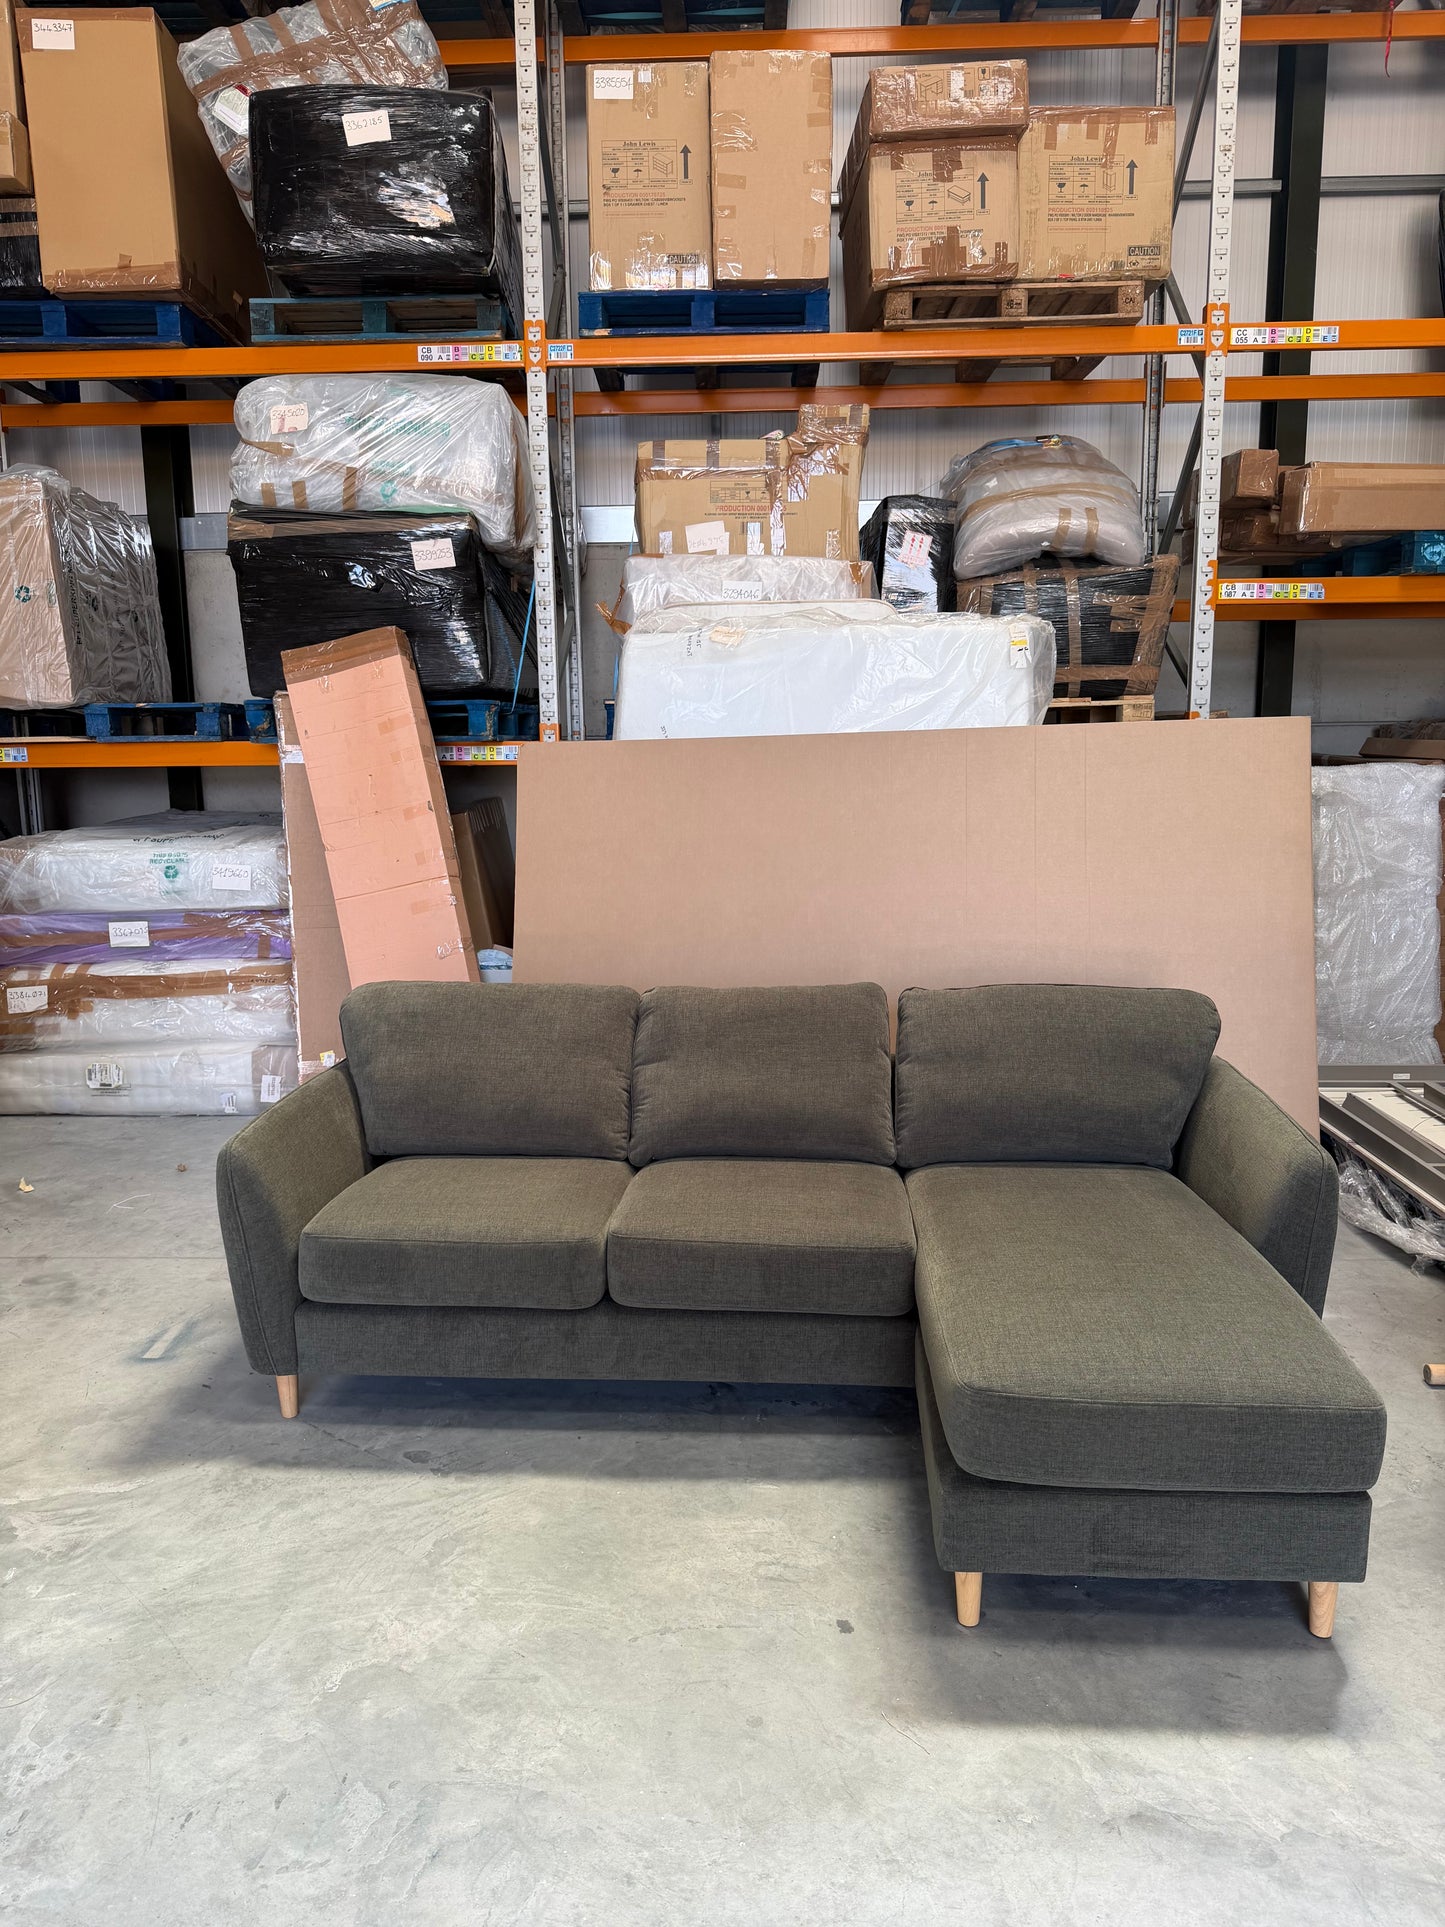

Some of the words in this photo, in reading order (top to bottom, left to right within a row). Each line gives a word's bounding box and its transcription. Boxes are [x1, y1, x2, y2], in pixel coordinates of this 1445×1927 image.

[1130, 246, 1160, 256] CAUTION
[1236, 329, 1248, 337] CC
[1235, 336, 1249, 344] 055
[1287, 335, 1294, 343] C
[421, 346, 432, 354] CB
